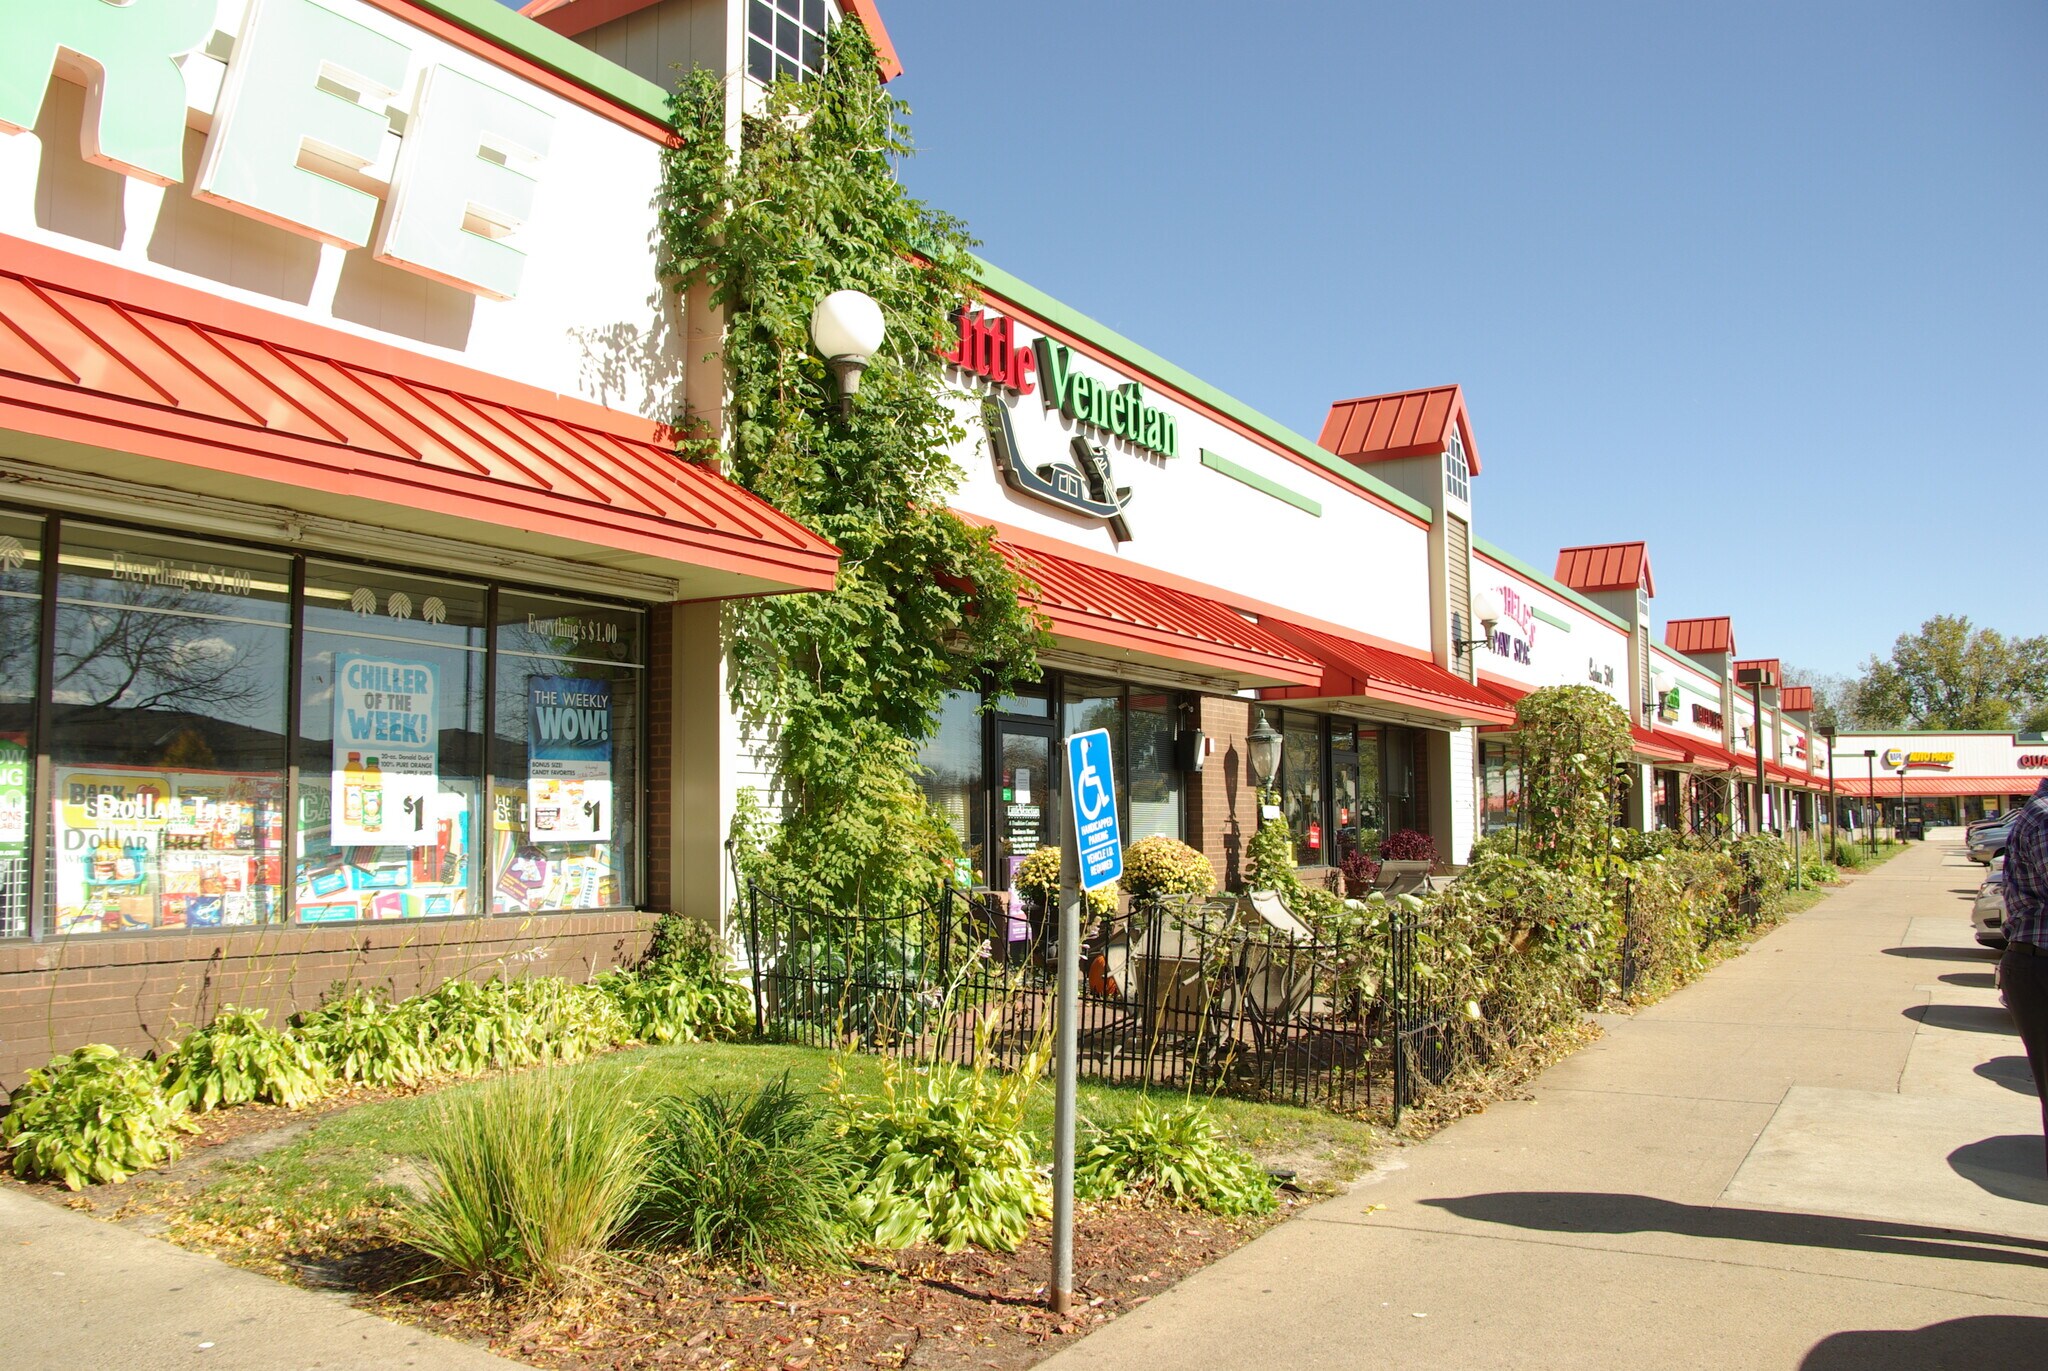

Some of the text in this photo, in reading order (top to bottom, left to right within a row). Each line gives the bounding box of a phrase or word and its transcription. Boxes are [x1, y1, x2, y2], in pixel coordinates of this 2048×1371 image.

[1040, 336, 1180, 459] Venetian
[112, 553, 251, 596] Everything's $1.00
[528, 612, 617, 645] Everything's $1.00
[1493, 629, 1511, 658] PAW
[347, 663, 428, 694] CHILLER
[364, 692, 412, 712] OF THE
[534, 690, 608, 708] THE WEEKLY
[347, 708, 428, 744] WEEK!
[536, 707, 609, 741] WOW!
[1908, 751, 1930, 762] AUTO
[1931, 751, 1955, 762] PARTS
[69, 783, 125, 806] BACK
[497, 793, 521, 809] ACK
[403, 795, 424, 832] $1
[584, 800, 600, 832] $1
[1080, 816, 1114, 836] HANDICAPPED
[1088, 829, 1109, 846] PARKING
[1086, 848, 1107, 865] VEHICLE
[1090, 858, 1114, 877] REQUIRED
